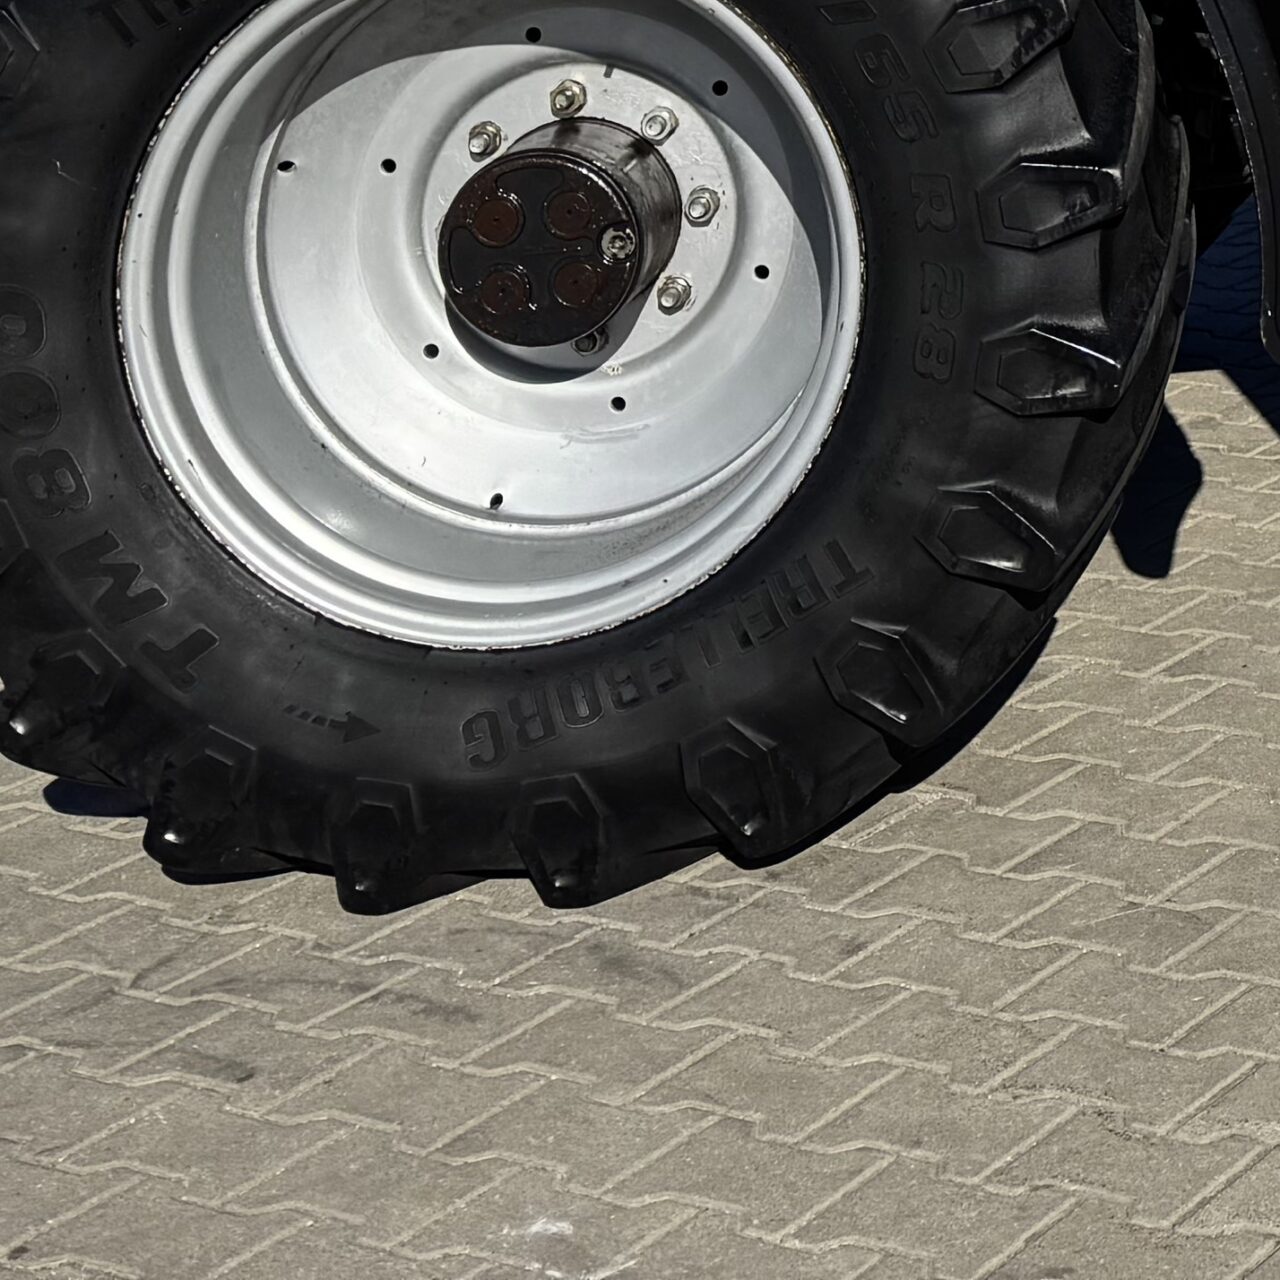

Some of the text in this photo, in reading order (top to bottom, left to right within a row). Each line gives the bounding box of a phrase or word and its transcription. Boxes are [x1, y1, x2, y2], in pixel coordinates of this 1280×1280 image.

[909, 172, 957, 234] R
[913, 260, 964, 384] 28
[459, 536, 872, 771] TRELLEBORG
